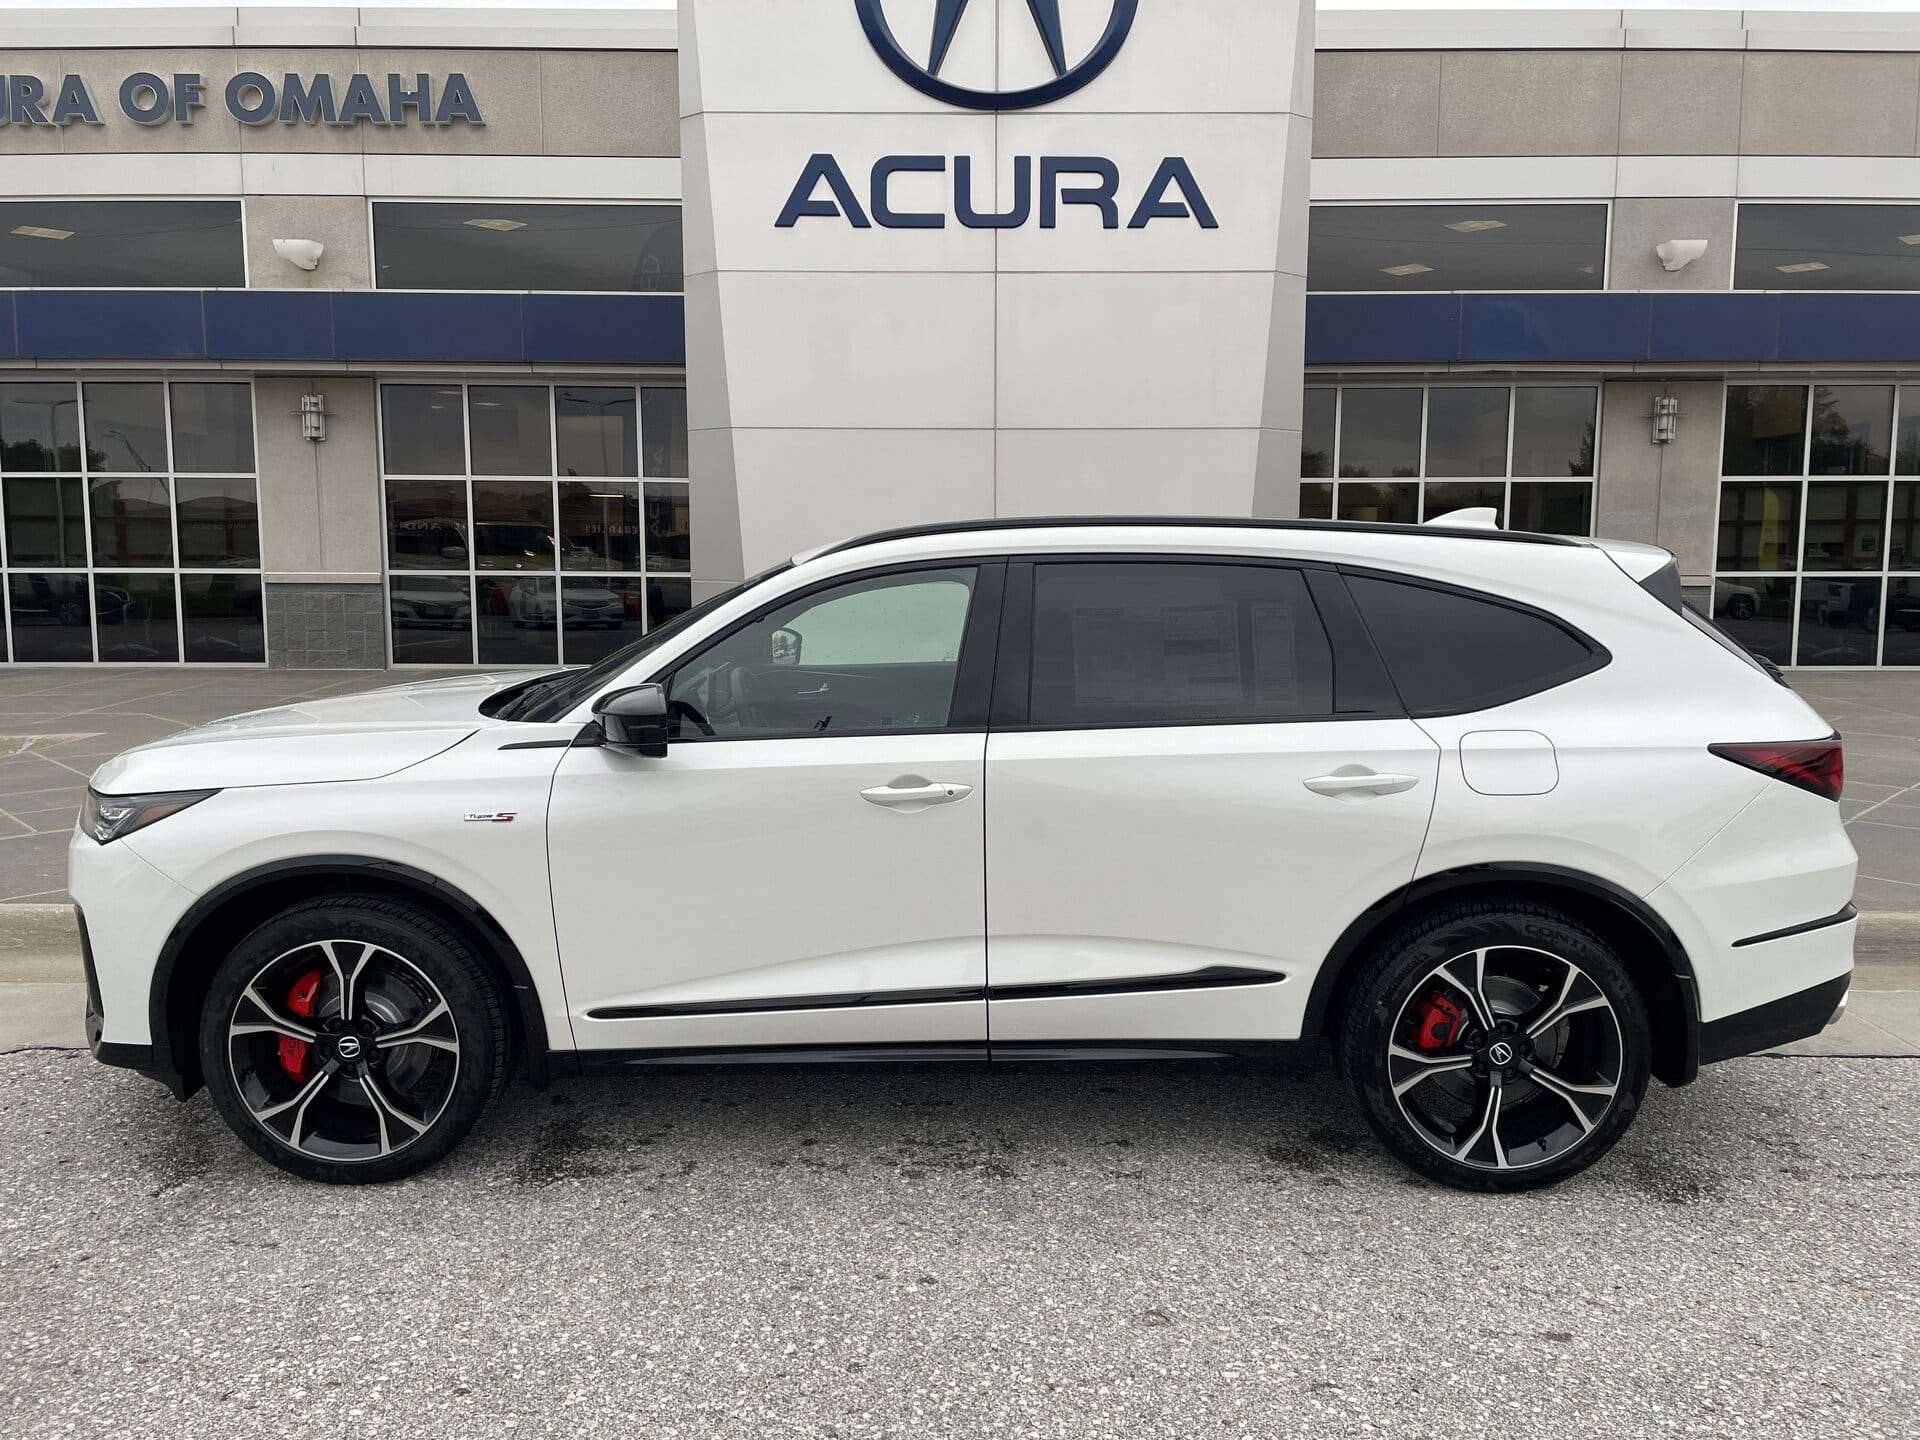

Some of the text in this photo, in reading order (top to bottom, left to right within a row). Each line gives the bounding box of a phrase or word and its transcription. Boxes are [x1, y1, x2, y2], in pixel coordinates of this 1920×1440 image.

[0, 71, 486, 126] RA OF OMAHA
[774, 153, 1219, 229] ACURA
[492, 812, 517, 822] S
